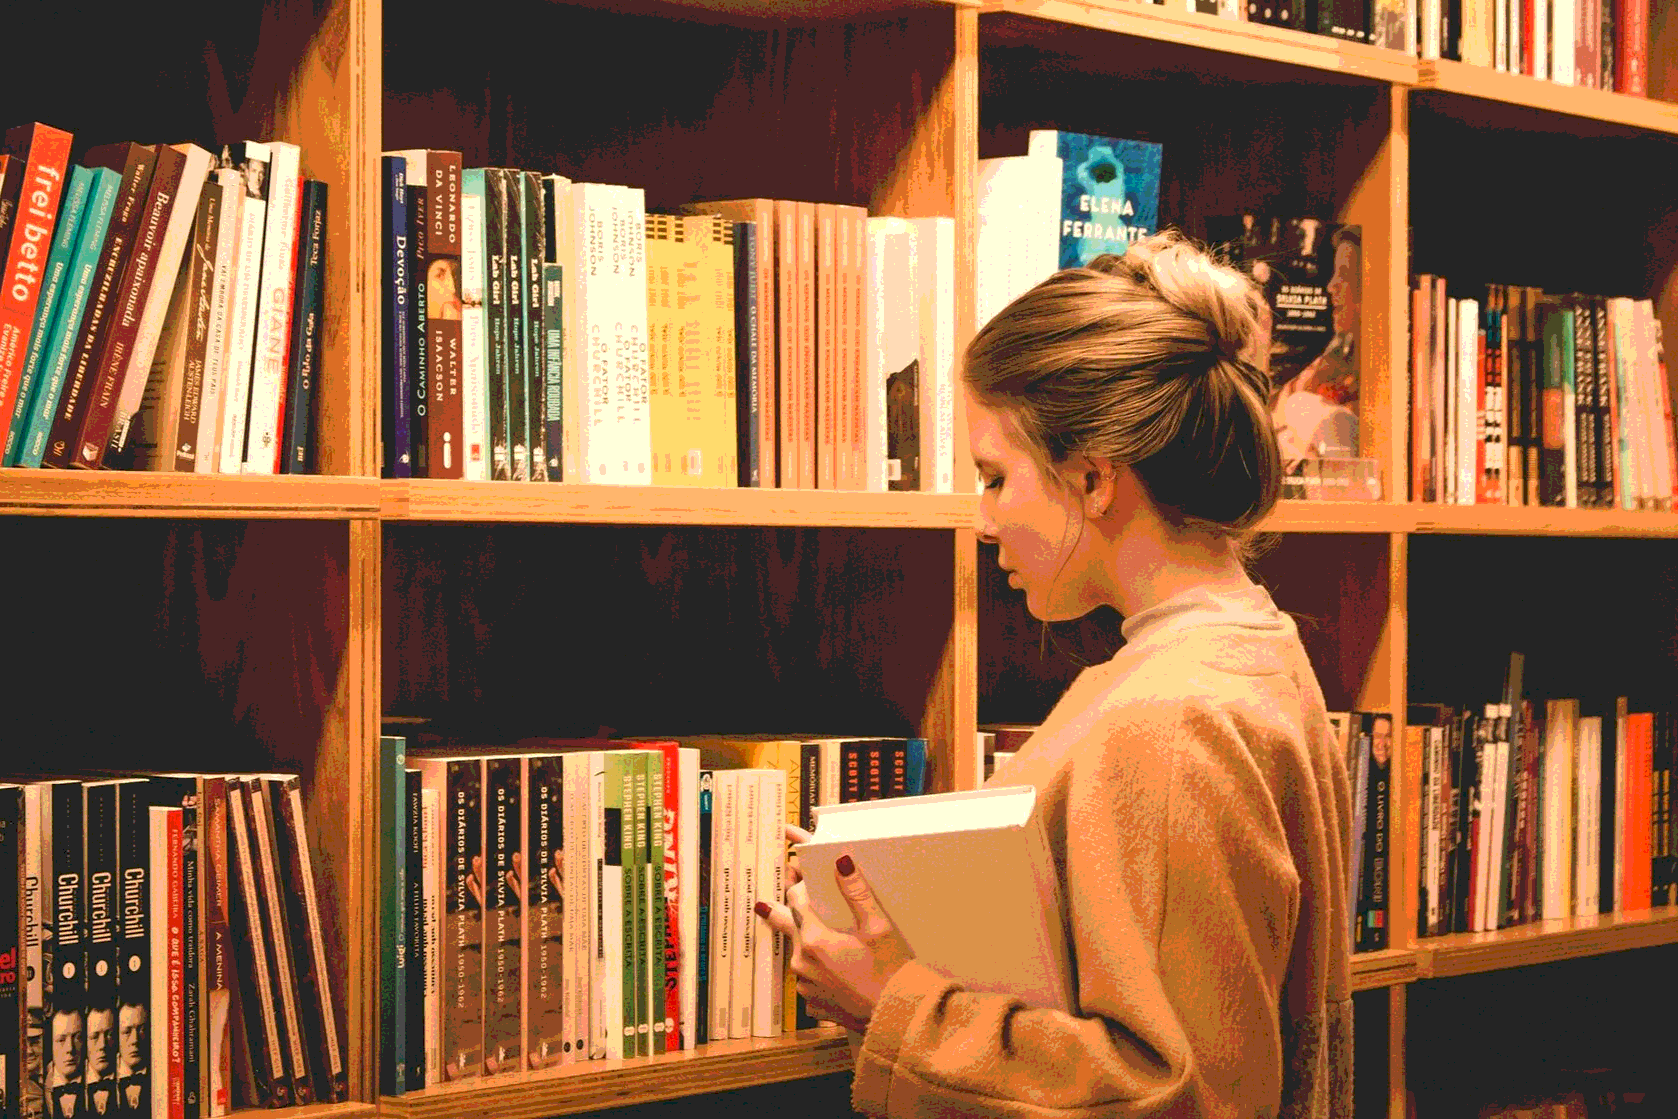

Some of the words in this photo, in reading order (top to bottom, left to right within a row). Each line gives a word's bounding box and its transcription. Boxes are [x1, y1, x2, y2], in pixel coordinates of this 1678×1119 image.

[29, 165, 60, 219] frei
[131, 164, 145, 193] Walter
[435, 169, 443, 188] DA
[143, 191, 170, 252] Beauvoir
[435, 194, 443, 236] VINCI
[1080, 195, 1134, 216] ELENA
[311, 209, 321, 241] Forjaz
[589, 205, 597, 276] JOHNSON
[612, 207, 620, 275] JOHNSON
[1063, 220, 1147, 242] FERRANTE
[310, 242, 319, 266] Teca
[635, 223, 643, 263] BORIS
[12, 223, 48, 302] betto
[52, 262, 64, 284] Uma
[80, 263, 93, 284] Uma
[394, 235, 407, 305] Devoção
[491, 255, 500, 278] Lab
[510, 255, 518, 278] Lab
[531, 258, 539, 281] Lab
[90, 237, 122, 333] ENCRUZILHADAS
[121, 252, 149, 328] apaixonada
[492, 280, 500, 305] Girl
[511, 280, 519, 305] Girl
[39, 284, 57, 328] esperança
[67, 286, 85, 330] esperança
[416, 282, 426, 333] ABERTO
[5, 326, 20, 367] Américo
[34, 330, 45, 351] mais
[61, 331, 74, 352] mais
[84, 334, 95, 350] DA
[269, 288, 285, 374] GIANE
[547, 329, 560, 348] UMA
[601, 342, 608, 353] O
[623, 340, 631, 351] O
[639, 342, 647, 353] O
[26, 352, 41, 374] forte
[54, 353, 67, 376] forte
[192, 360, 202, 385] JAMES
[417, 337, 426, 399] CAMINHO
[435, 330, 443, 402] ISAACSON
[449, 338, 457, 396] WALTER
[494, 343, 502, 375] Jahren
[547, 349, 562, 384] INFÂNCIA
[615, 321, 625, 424] CHURCHILL
[751, 350, 757, 364] DA
[21, 375, 31, 391] que
[49, 377, 60, 393] que
[65, 353, 89, 421] LIBERDADE
[99, 375, 116, 409] FRAIN
[592, 324, 603, 427] CHURCHILL
[624, 357, 632, 403] FATOR
[640, 359, 648, 405] FATOR
[14, 399, 25, 418] mar
[42, 400, 53, 419] mar
[190, 386, 201, 424] EDWARD
[417, 404, 426, 416] O
[547, 385, 560, 421] ROUBADA
[848, 752, 858, 792] SCOTT
[870, 751, 880, 791] SCOTT
[895, 751, 904, 790] SCOTT
[1377, 781, 1386, 791] O
[457, 791, 465, 804] OS
[497, 788, 505, 801] OS
[541, 786, 548, 799] OS
[623, 775, 632, 821] STEPHEN
[636, 774, 646, 820] STEPHEN
[653, 773, 662, 819] STEPHEN
[497, 806, 506, 849] DIÁRIOS
[541, 803, 549, 847] DIÁRIOS
[1376, 795, 1385, 830] LIVRO
[457, 809, 466, 853] DIÁRIOS
[623, 824, 632, 849] KING
[636, 822, 646, 848] KING
[653, 822, 662, 847] KING
[1375, 833, 1384, 852] DO
[171, 829, 179, 878] FERNANDO
[457, 857, 465, 870] DE
[497, 853, 505, 867] DE
[541, 850, 548, 864] DE
[187, 860, 195, 887] Minha
[497, 870, 505, 907] SYLVIA
[624, 867, 632, 906] SOBRE
[654, 866, 663, 903] SOBRE
[58, 873, 79, 945] Churchill
[92, 871, 111, 943] Churchill
[124, 867, 144, 939] Churchill
[171, 880, 179, 919] GABEIRA
[457, 874, 465, 911] SYLVIA
[625, 909, 632, 918] A
[654, 906, 662, 915] A
[171, 937, 179, 957] QUE
[187, 936, 196, 969] traidora
[215, 931, 222, 940] A
[624, 919, 632, 968] ESCRITA
[654, 916, 663, 964] ESCRITA
[188, 983, 196, 1008] Zarah
[171, 994, 181, 1063] COMPANHEIRO?
